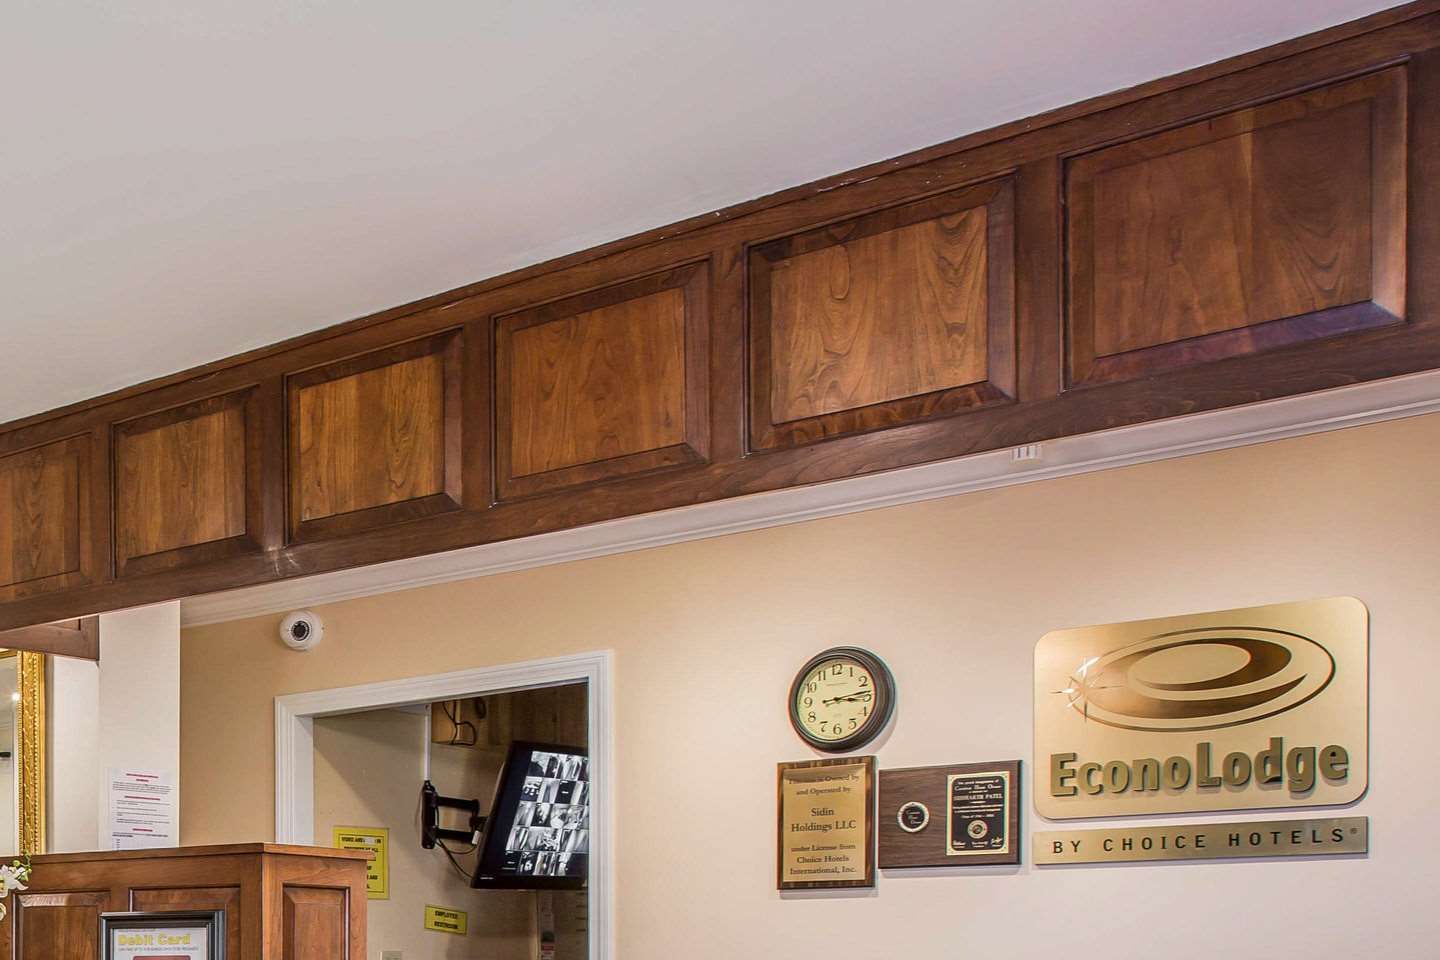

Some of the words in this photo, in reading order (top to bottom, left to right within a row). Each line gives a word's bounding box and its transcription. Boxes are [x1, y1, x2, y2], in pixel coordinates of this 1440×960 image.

[832, 663, 842, 676] 12
[818, 671, 826, 681] 11
[858, 676, 868, 687] 2
[806, 682, 817, 693] 10
[803, 697, 813, 708] 9
[808, 711, 817, 723] 8
[820, 721, 828, 732] 7
[832, 723, 842, 735] 6
[1050, 737, 1350, 797] EconoLodge
[810, 807, 835, 817] Sidin
[791, 823, 833, 833] Holdings
[835, 820, 856, 830] LLC
[1053, 840, 1081, 854] BY
[1103, 835, 1206, 852] CHOICE
[790, 867, 840, 875] International,
[117, 934, 153, 945] Debit
[157, 932, 192, 945] Card
